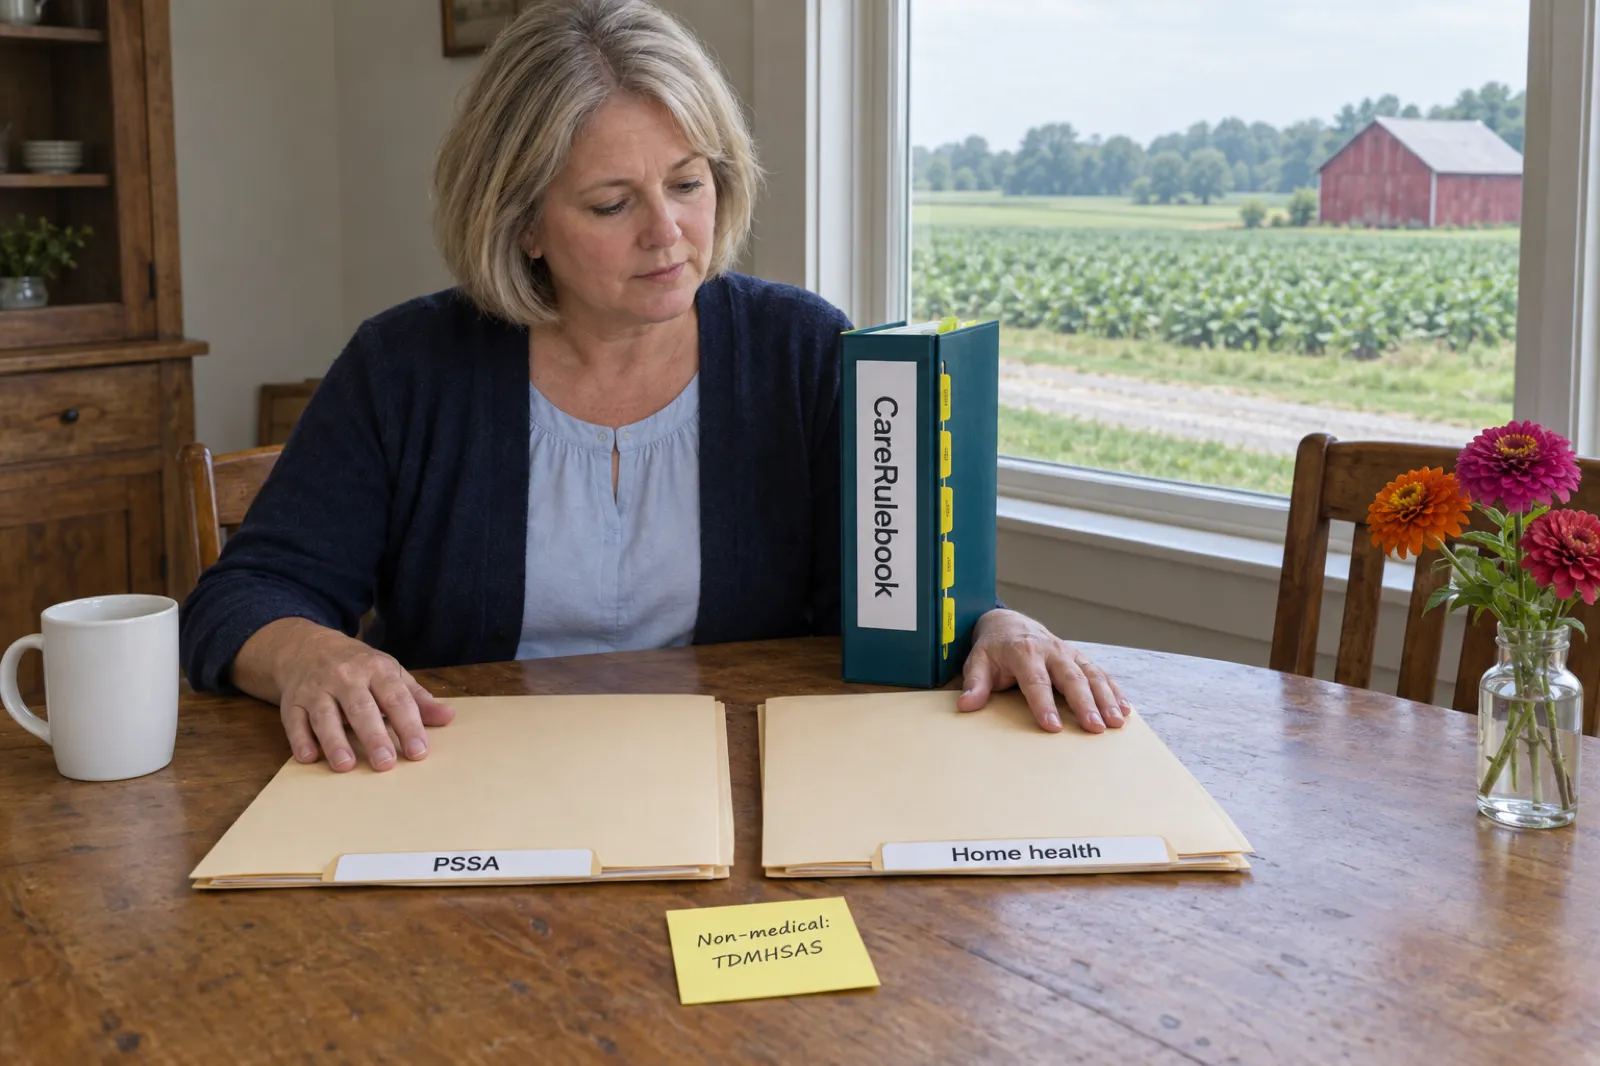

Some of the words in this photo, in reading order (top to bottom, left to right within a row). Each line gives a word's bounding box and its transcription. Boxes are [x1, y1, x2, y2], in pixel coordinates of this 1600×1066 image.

[873, 396, 900, 598] CareRulebook
[433, 856, 500, 872] PSSA
[951, 847, 1022, 862] Home
[1028, 843, 1101, 860] health
[697, 915, 830, 947] Non-medical:
[712, 940, 823, 969] TDMHSAS
